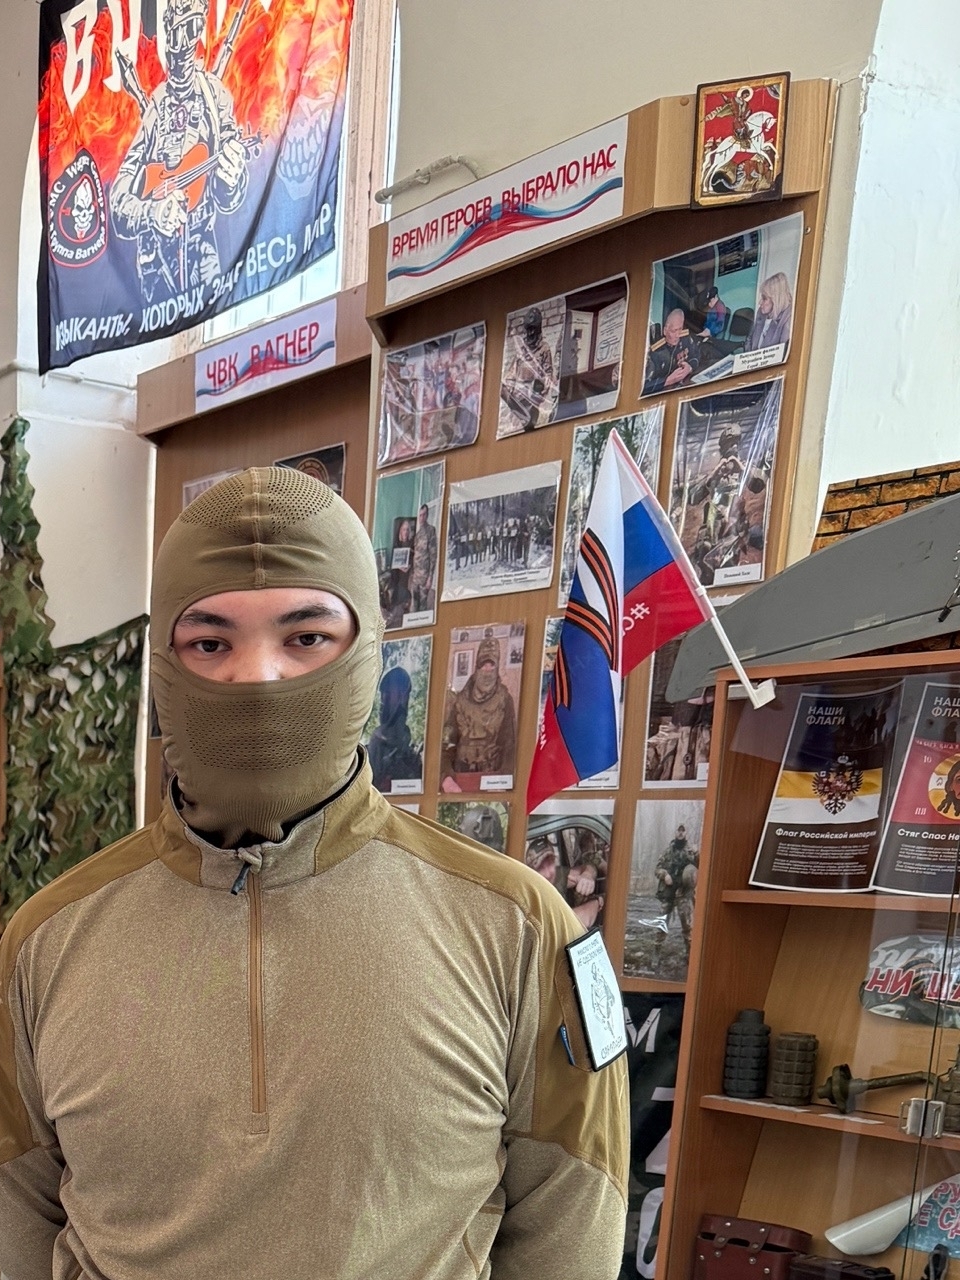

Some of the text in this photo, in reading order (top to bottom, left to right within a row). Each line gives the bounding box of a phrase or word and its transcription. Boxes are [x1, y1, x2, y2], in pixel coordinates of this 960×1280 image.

[392, 143, 618, 257] ВРЕМЯ ГЕРОЕВ ВЫБРАЛО НАС
[246, 233, 297, 278] ВЕСЬ
[206, 322, 320, 387] ЧВК ВАГНЕР
[805, 715, 845, 726] ФЛАГИ
[807, 706, 844, 716] НАШИ
[775, 828, 878, 840] Флаг Российской империи
[897, 828, 946, 841] Стяг Спас
[865, 967, 916, 996] НИ
